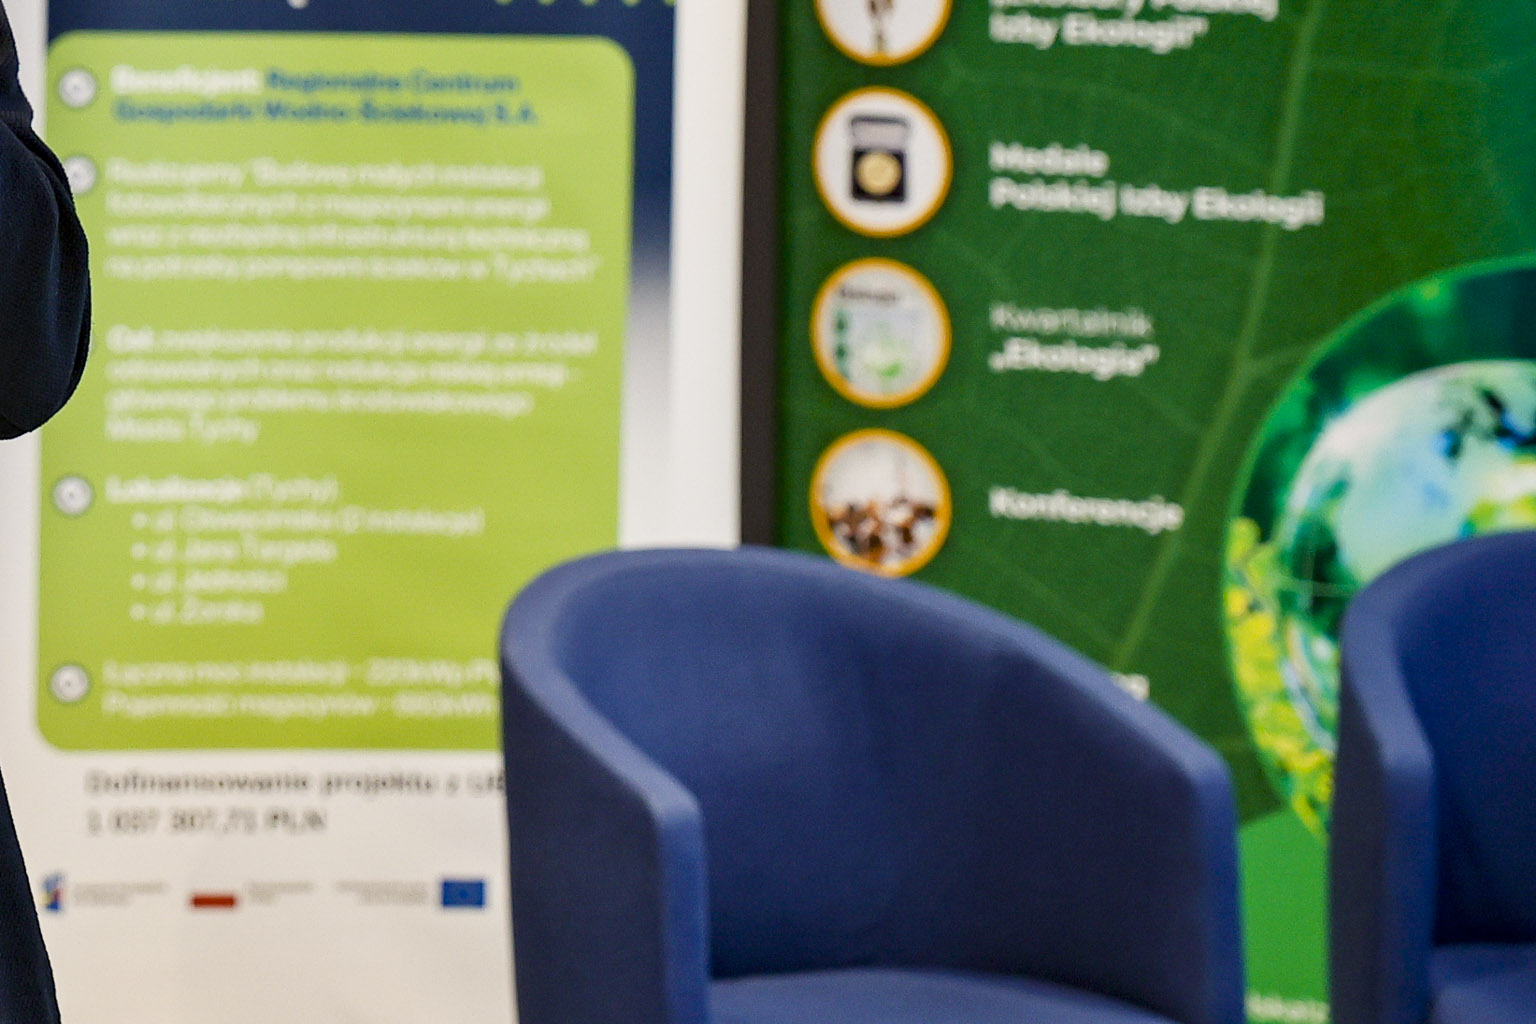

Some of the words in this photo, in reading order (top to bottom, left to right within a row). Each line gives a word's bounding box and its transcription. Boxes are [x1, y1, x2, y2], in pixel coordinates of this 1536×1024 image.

[989, 13, 1059, 49] Izby
[410, 69, 520, 94] Centrum
[990, 142, 1109, 176] Medale
[990, 178, 1117, 220] Polskiej
[1119, 183, 1191, 224] Izby
[1192, 186, 1324, 229] Ekologii
[990, 302, 1155, 337] Kwartalnik
[989, 487, 1184, 533] Konferencje
